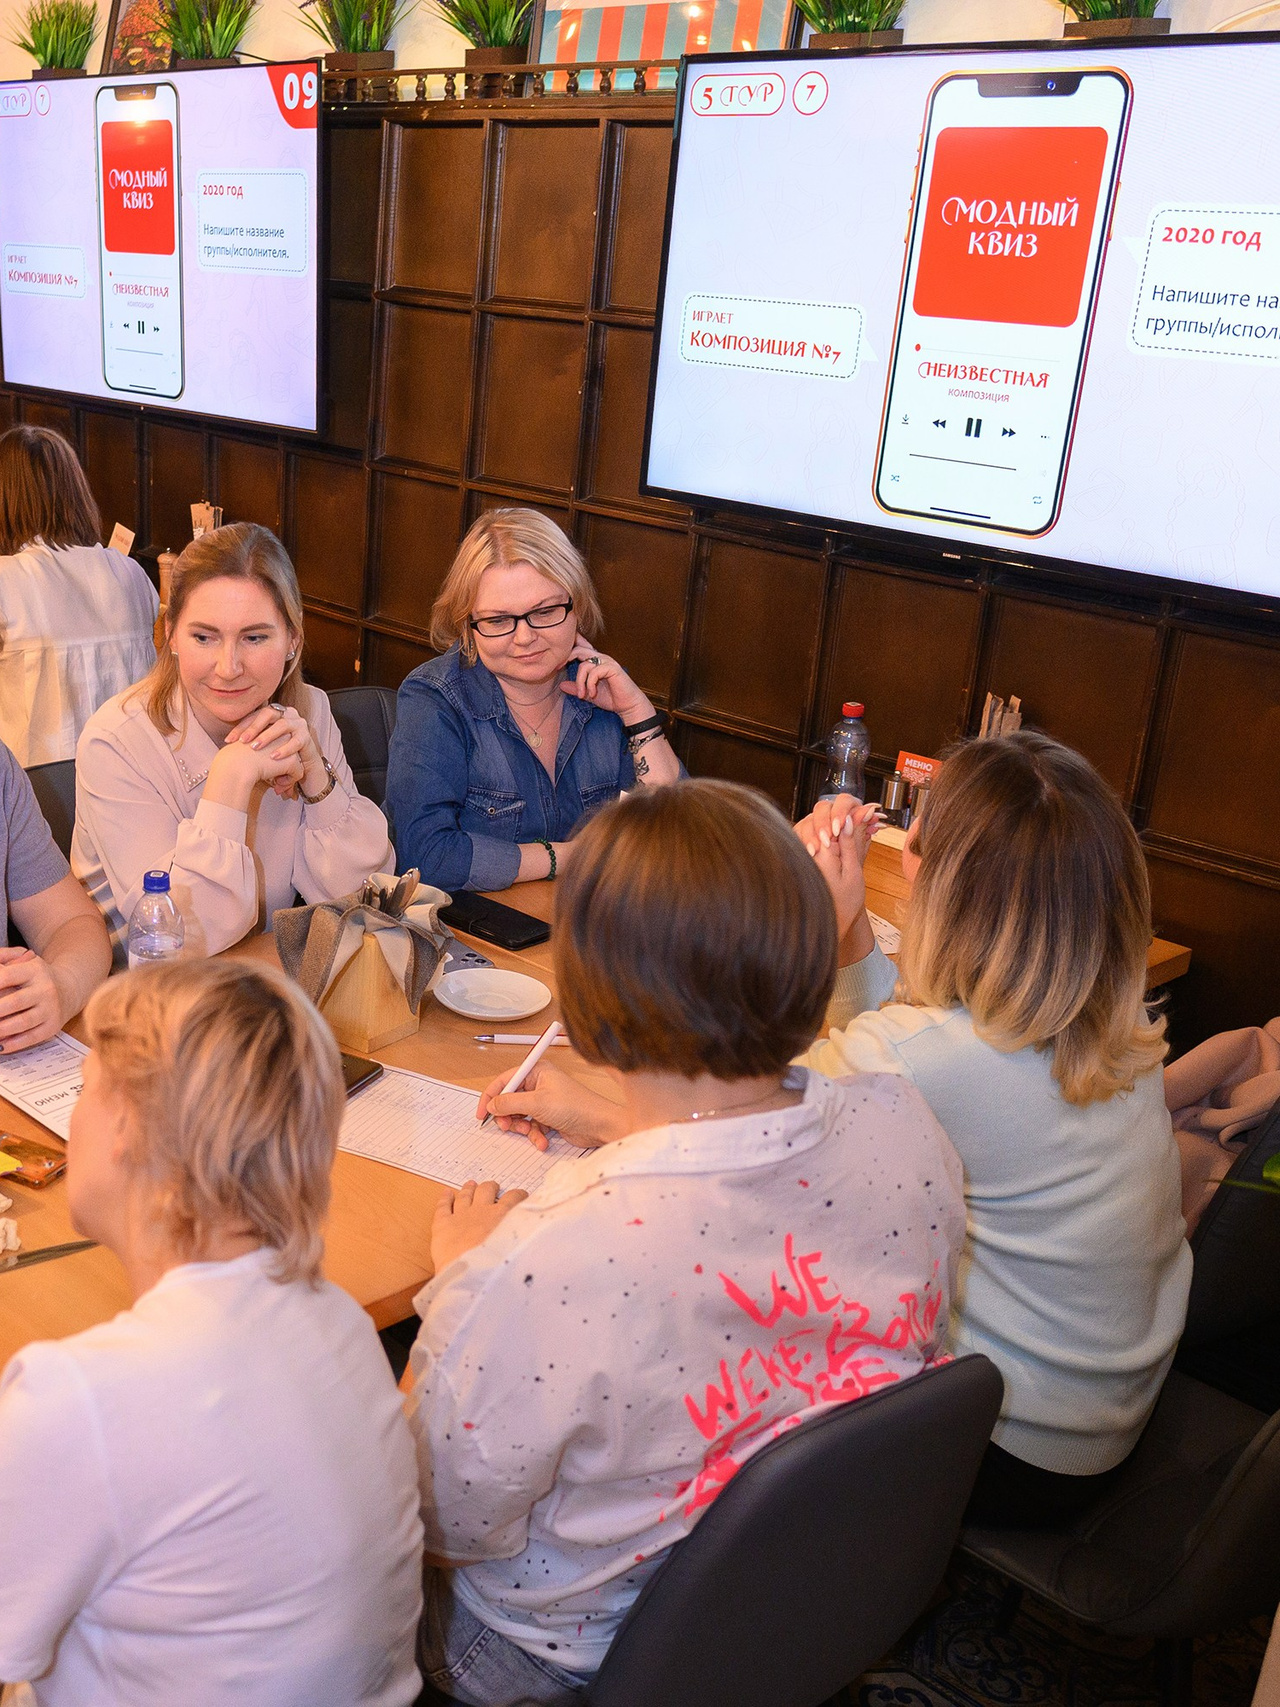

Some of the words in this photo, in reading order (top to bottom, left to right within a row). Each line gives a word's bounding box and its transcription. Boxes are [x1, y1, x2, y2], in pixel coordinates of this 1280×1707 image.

[283, 71, 317, 110] 09
[700, 87, 713, 110] 5
[720, 82, 774, 106] ТУР
[806, 84, 817, 102] 7
[109, 167, 168, 189] МОДНЫЙ
[123, 191, 154, 209] КВИЗ
[203, 184, 225, 196] 2020
[226, 186, 244, 199] год
[941, 196, 1079, 228] МОДНЫЙ
[203, 223, 244, 236] Напишите
[246, 227, 285, 238] название
[1162, 227, 1215, 244] 2020
[1221, 230, 1261, 252] год
[968, 231, 1038, 258] КВИЗ
[8, 269, 62, 285] КОМПОЗИЦИЯ
[112, 283, 169, 298] НЕИЗВЕСТНАЯ
[1152, 285, 1251, 307] Напишите
[1256, 295, 1280, 309] на
[692, 310, 735, 325] ИГРАЕТ
[1146, 317, 1280, 340] группы/испол
[690, 330, 807, 358] КОМПОЗИЦИЯ
[811, 343, 841, 365] №7
[918, 361, 1051, 388] НЕИЗВЕСТНАЯ
[718, 1232, 843, 1329] WE
